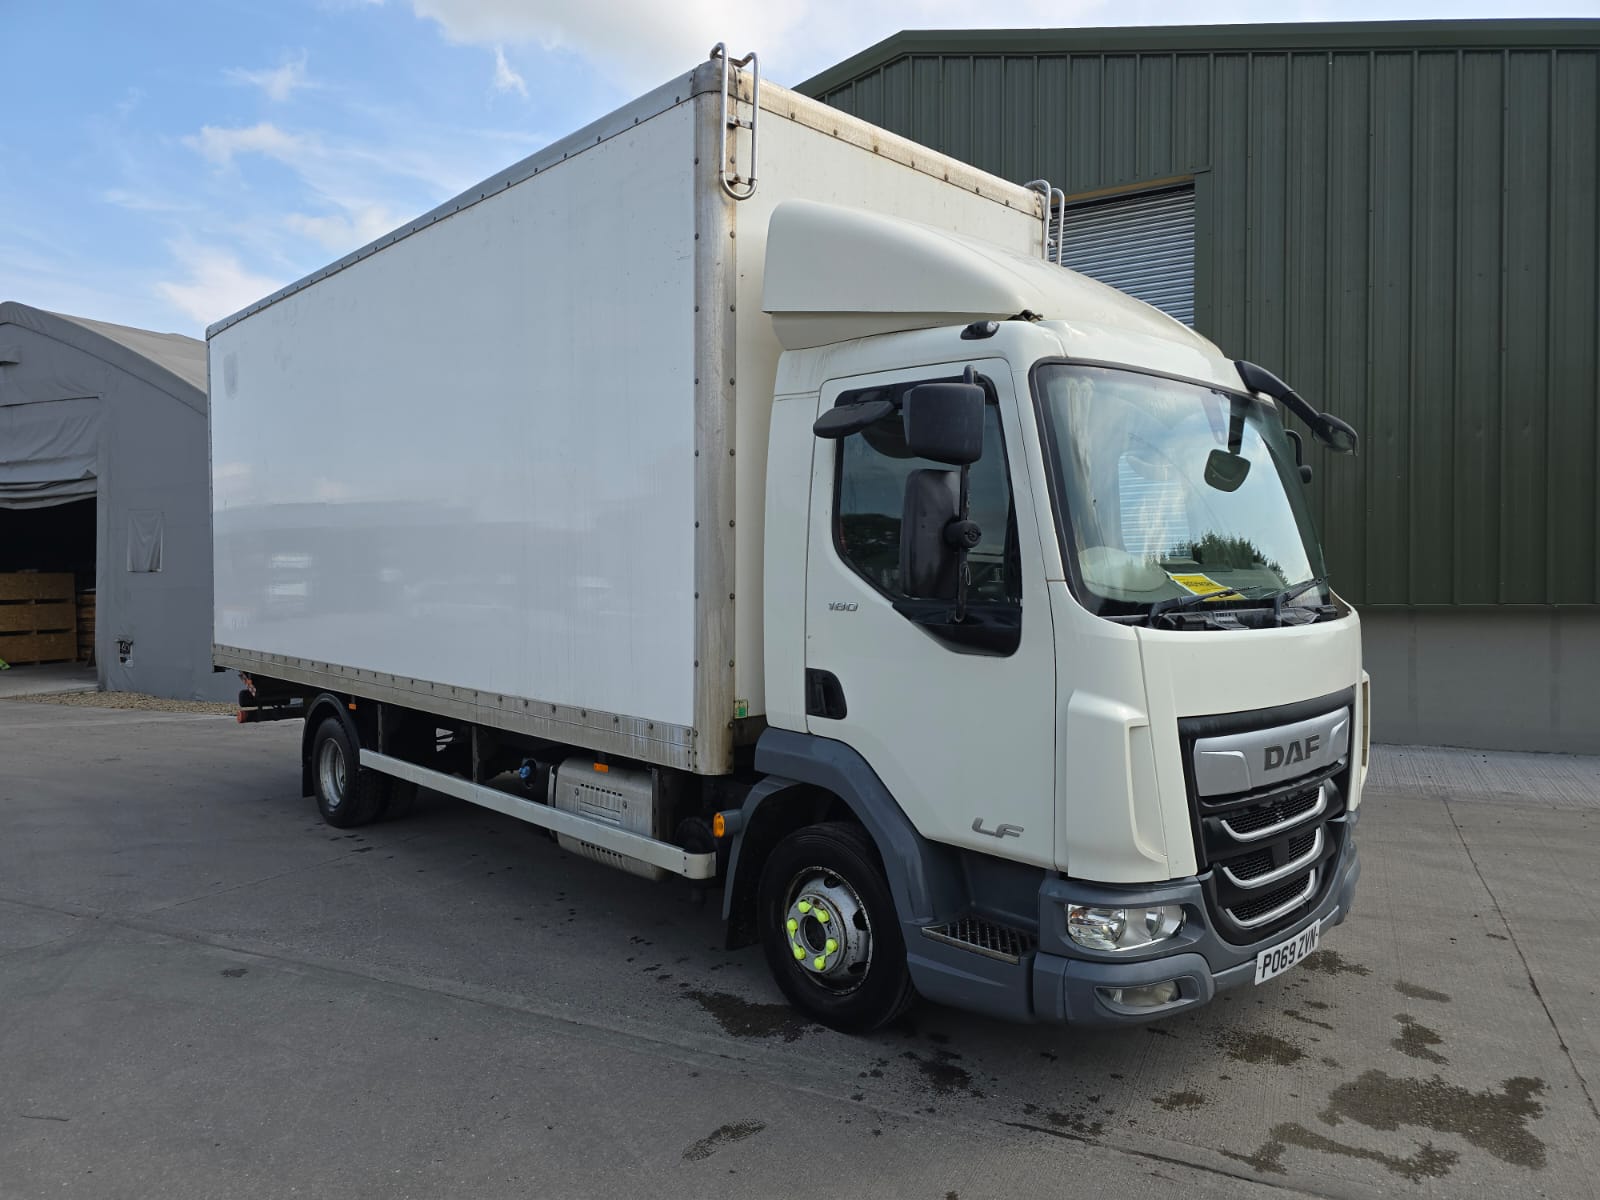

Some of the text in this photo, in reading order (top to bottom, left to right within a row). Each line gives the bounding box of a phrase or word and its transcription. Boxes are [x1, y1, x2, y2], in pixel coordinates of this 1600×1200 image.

[828, 601, 859, 612] 180
[1264, 735, 1320, 771] DAF
[972, 817, 1025, 839] LF
[1262, 924, 1317, 979] PO69 ZYN
